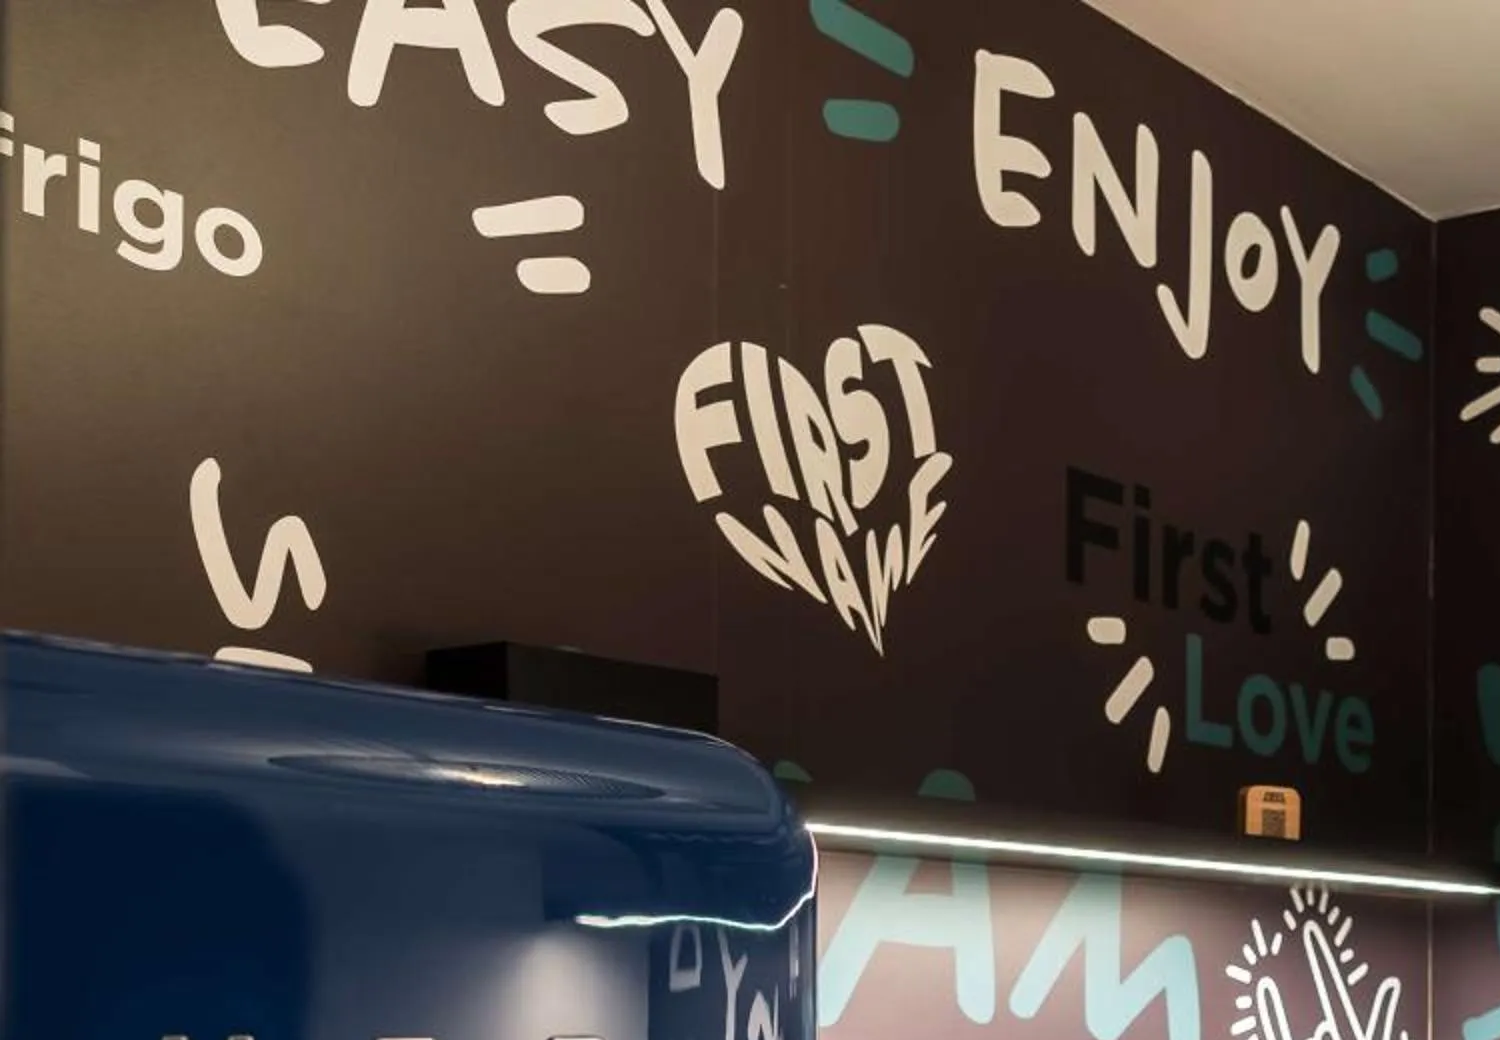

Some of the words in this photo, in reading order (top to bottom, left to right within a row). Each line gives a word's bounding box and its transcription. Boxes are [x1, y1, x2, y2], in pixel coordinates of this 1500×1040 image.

[973, 49, 1340, 374] ENJOY
[674, 323, 936, 537] FIRST
[715, 451, 953, 658] NAME
[1065, 464, 1274, 636] First
[1185, 632, 1376, 773] Love
